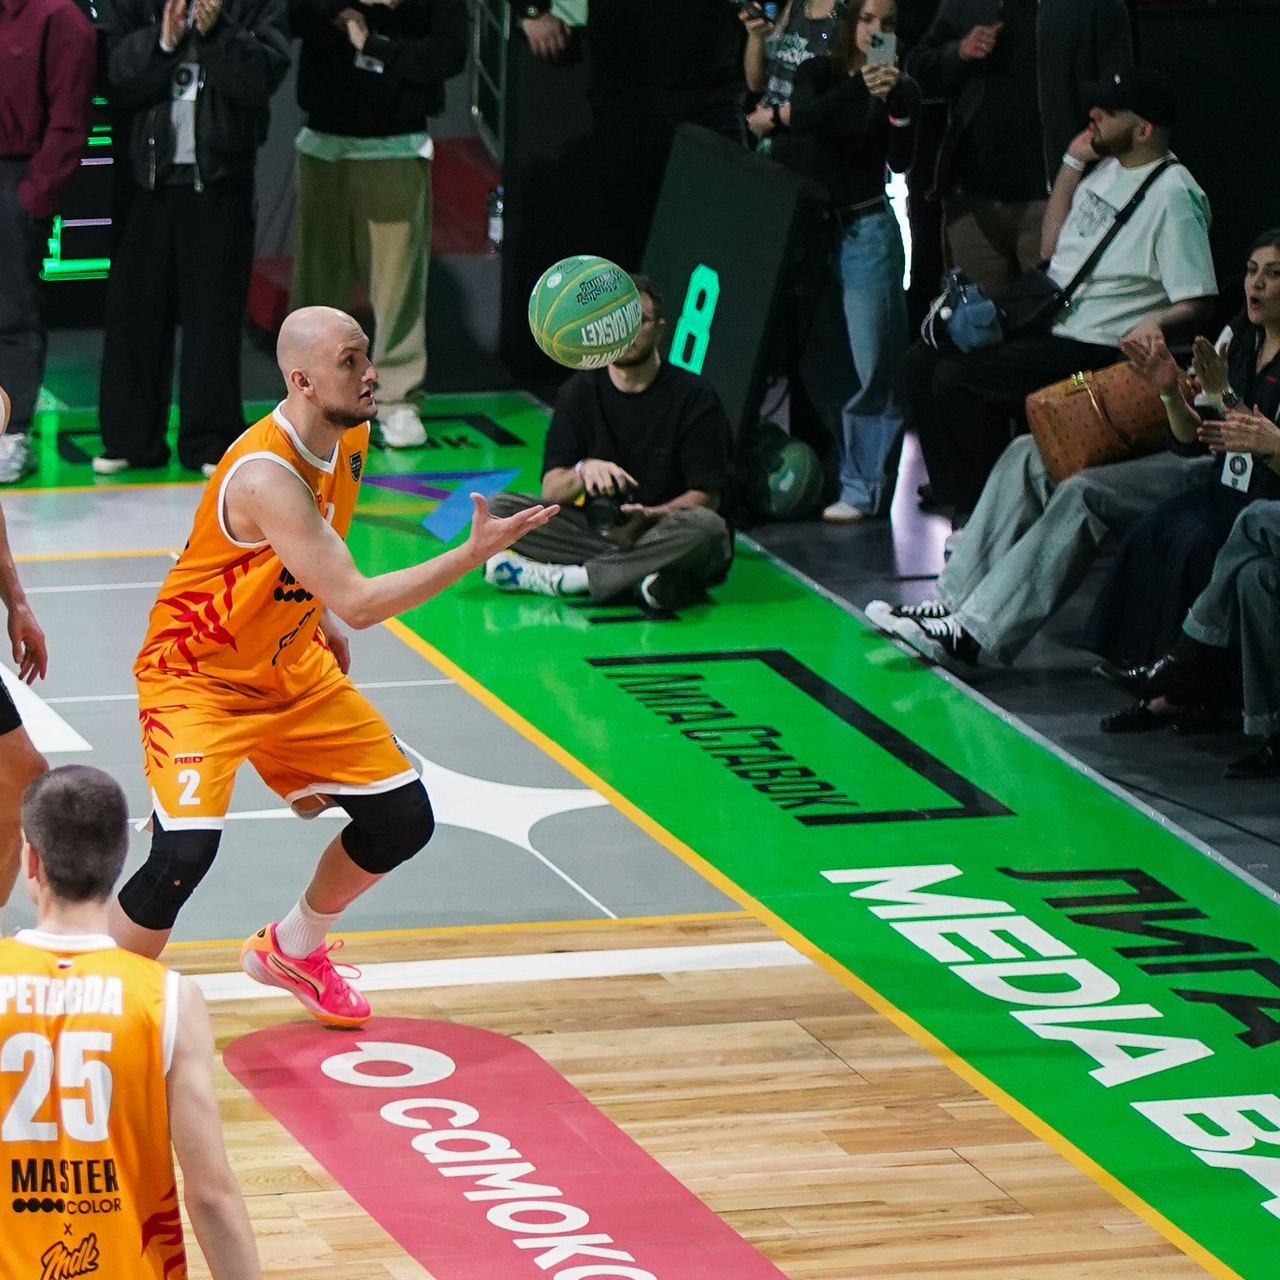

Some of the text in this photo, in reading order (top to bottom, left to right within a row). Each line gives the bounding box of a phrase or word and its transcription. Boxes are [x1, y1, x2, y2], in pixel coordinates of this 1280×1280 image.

[581, 306, 628, 346] BASKET
[174, 756, 204, 764] RED
[177, 768, 202, 806] 2
[820, 863, 1215, 1088] MEDIA
[10, 1157, 118, 1195] MASTER
[66, 1199, 122, 1215] COLOR
